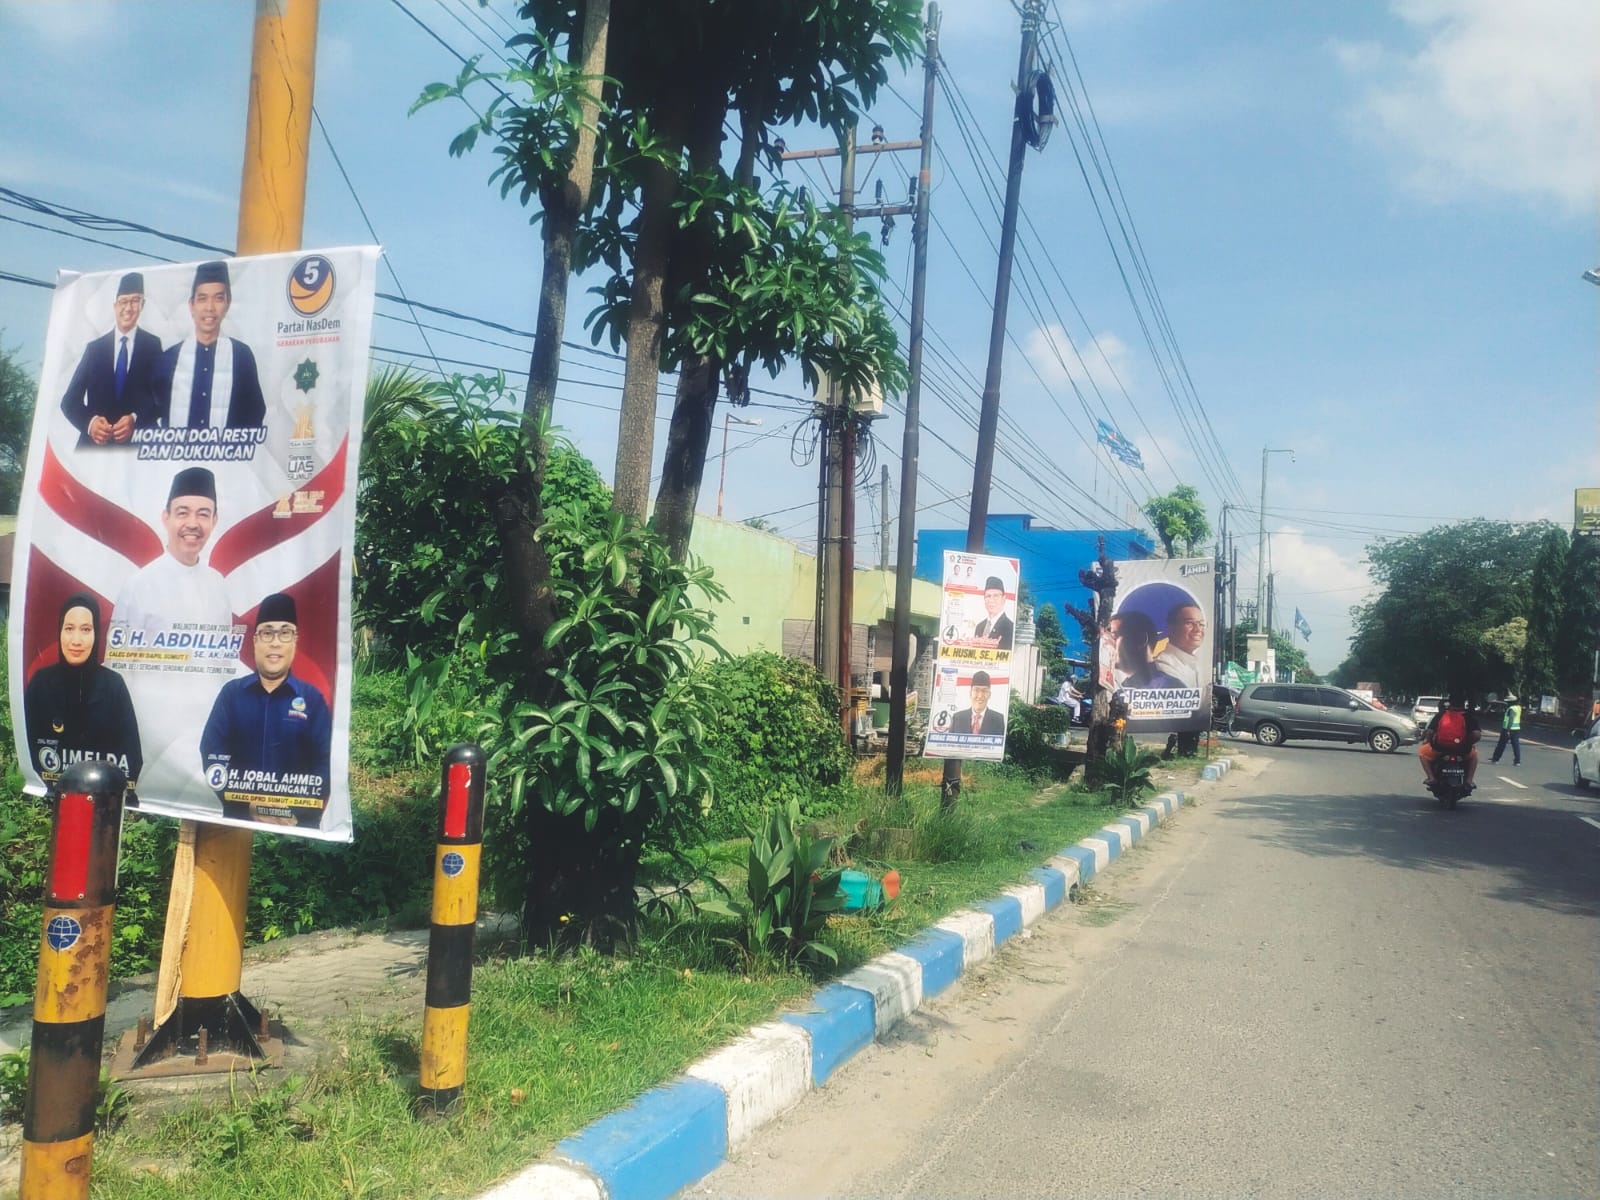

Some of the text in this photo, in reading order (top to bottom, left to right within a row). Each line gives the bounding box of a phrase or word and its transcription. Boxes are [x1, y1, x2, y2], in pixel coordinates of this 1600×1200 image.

[303, 260, 320, 285] 5
[277, 318, 341, 334] Partai NasDem
[131, 426, 267, 443] MOHON DOA RESTU
[139, 444, 255, 460] DAN DUKUNGAN
[288, 460, 314, 473] UAS
[946, 625, 954, 640] 4
[130, 632, 147, 646] H.
[153, 632, 242, 650] ABDILLAH
[941, 647, 951, 657] M.
[952, 648, 977, 660] HUSNI,
[996, 651, 1010, 661] MM
[1133, 689, 1200, 700] PRANANDA
[1133, 700, 1199, 710] SURYA PALOH
[937, 710, 948, 727] 8
[229, 768, 240, 781] H.
[243, 769, 278, 784] IQBAL
[280, 772, 323, 786] AHMED
[228, 780, 322, 796] SAUKI PULUNGAN, LC
[231, 793, 249, 801] CALEG
[250, 794, 266, 803] DPRD
[268, 796, 289, 804] SUMUT
[294, 798, 312, 806] DAPIL
